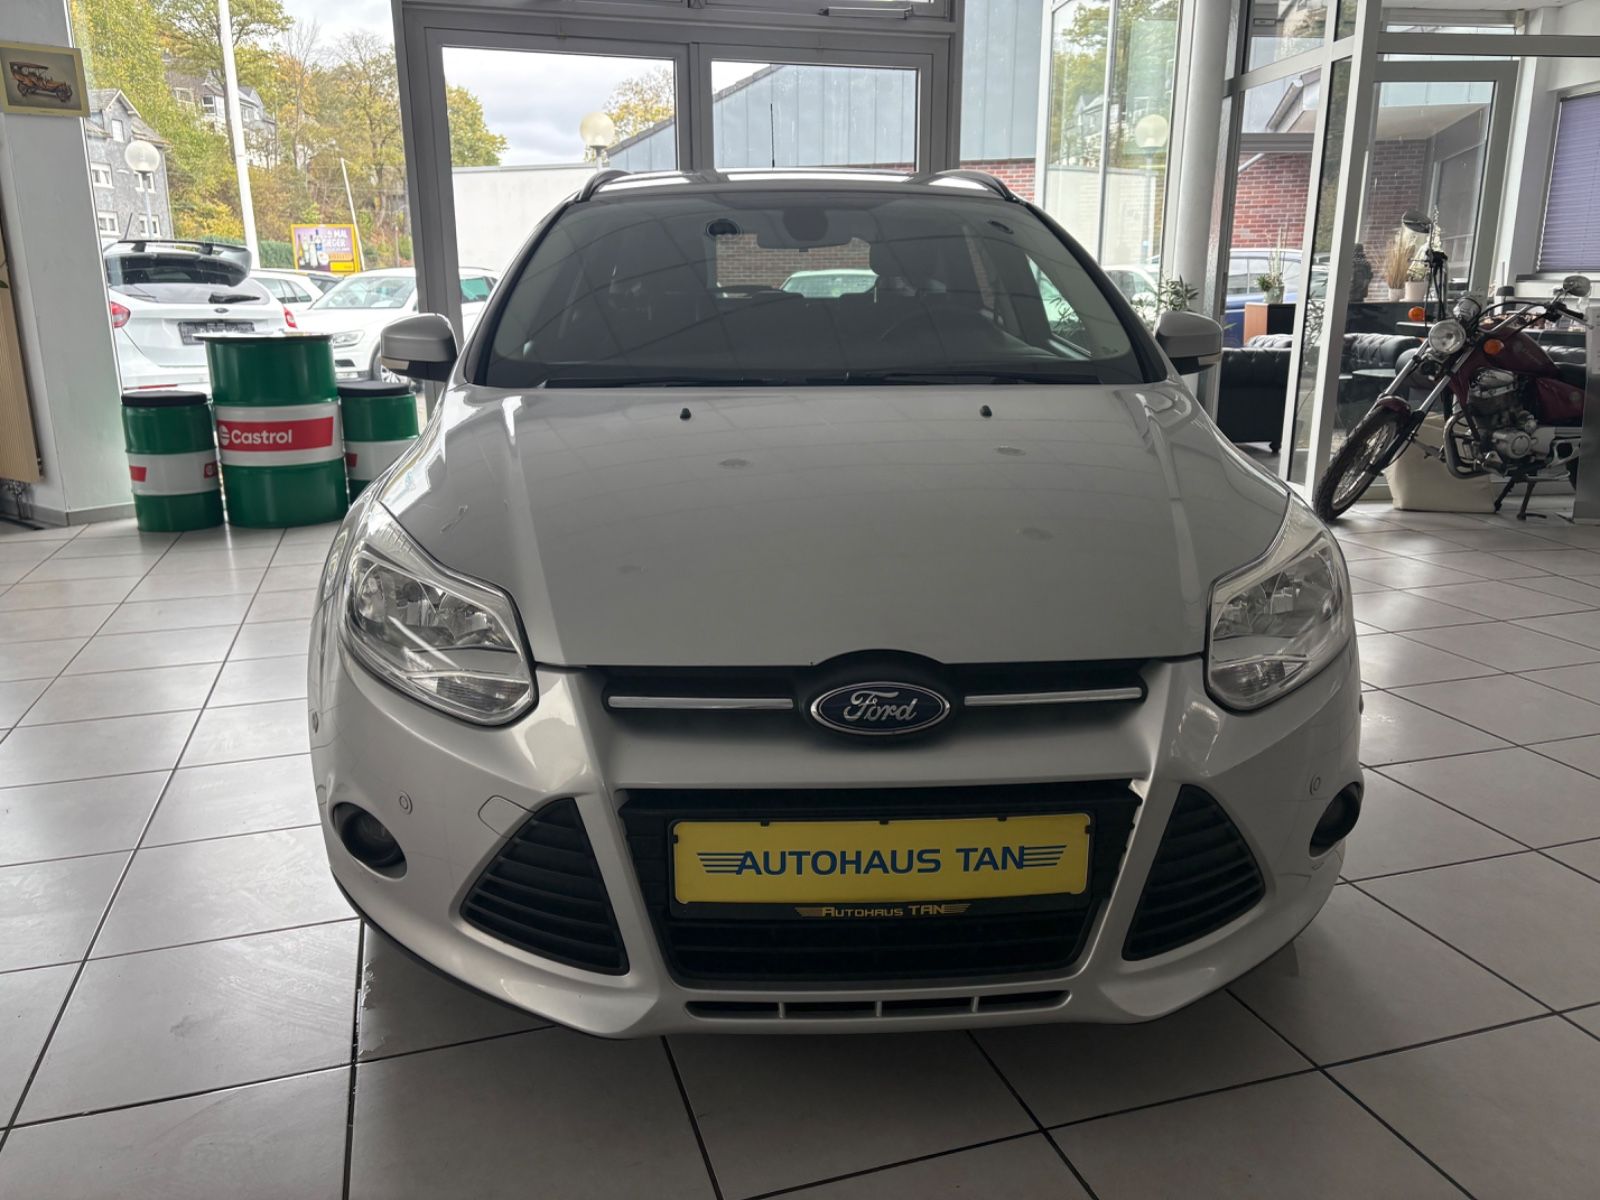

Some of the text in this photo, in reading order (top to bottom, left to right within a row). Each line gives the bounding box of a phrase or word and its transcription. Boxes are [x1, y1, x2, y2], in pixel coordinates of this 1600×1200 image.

[231, 429, 293, 444] Castrol
[843, 690, 918, 721] Ford
[735, 845, 1025, 875] AUTOHAUS TAN
[908, 904, 945, 915] TAN
